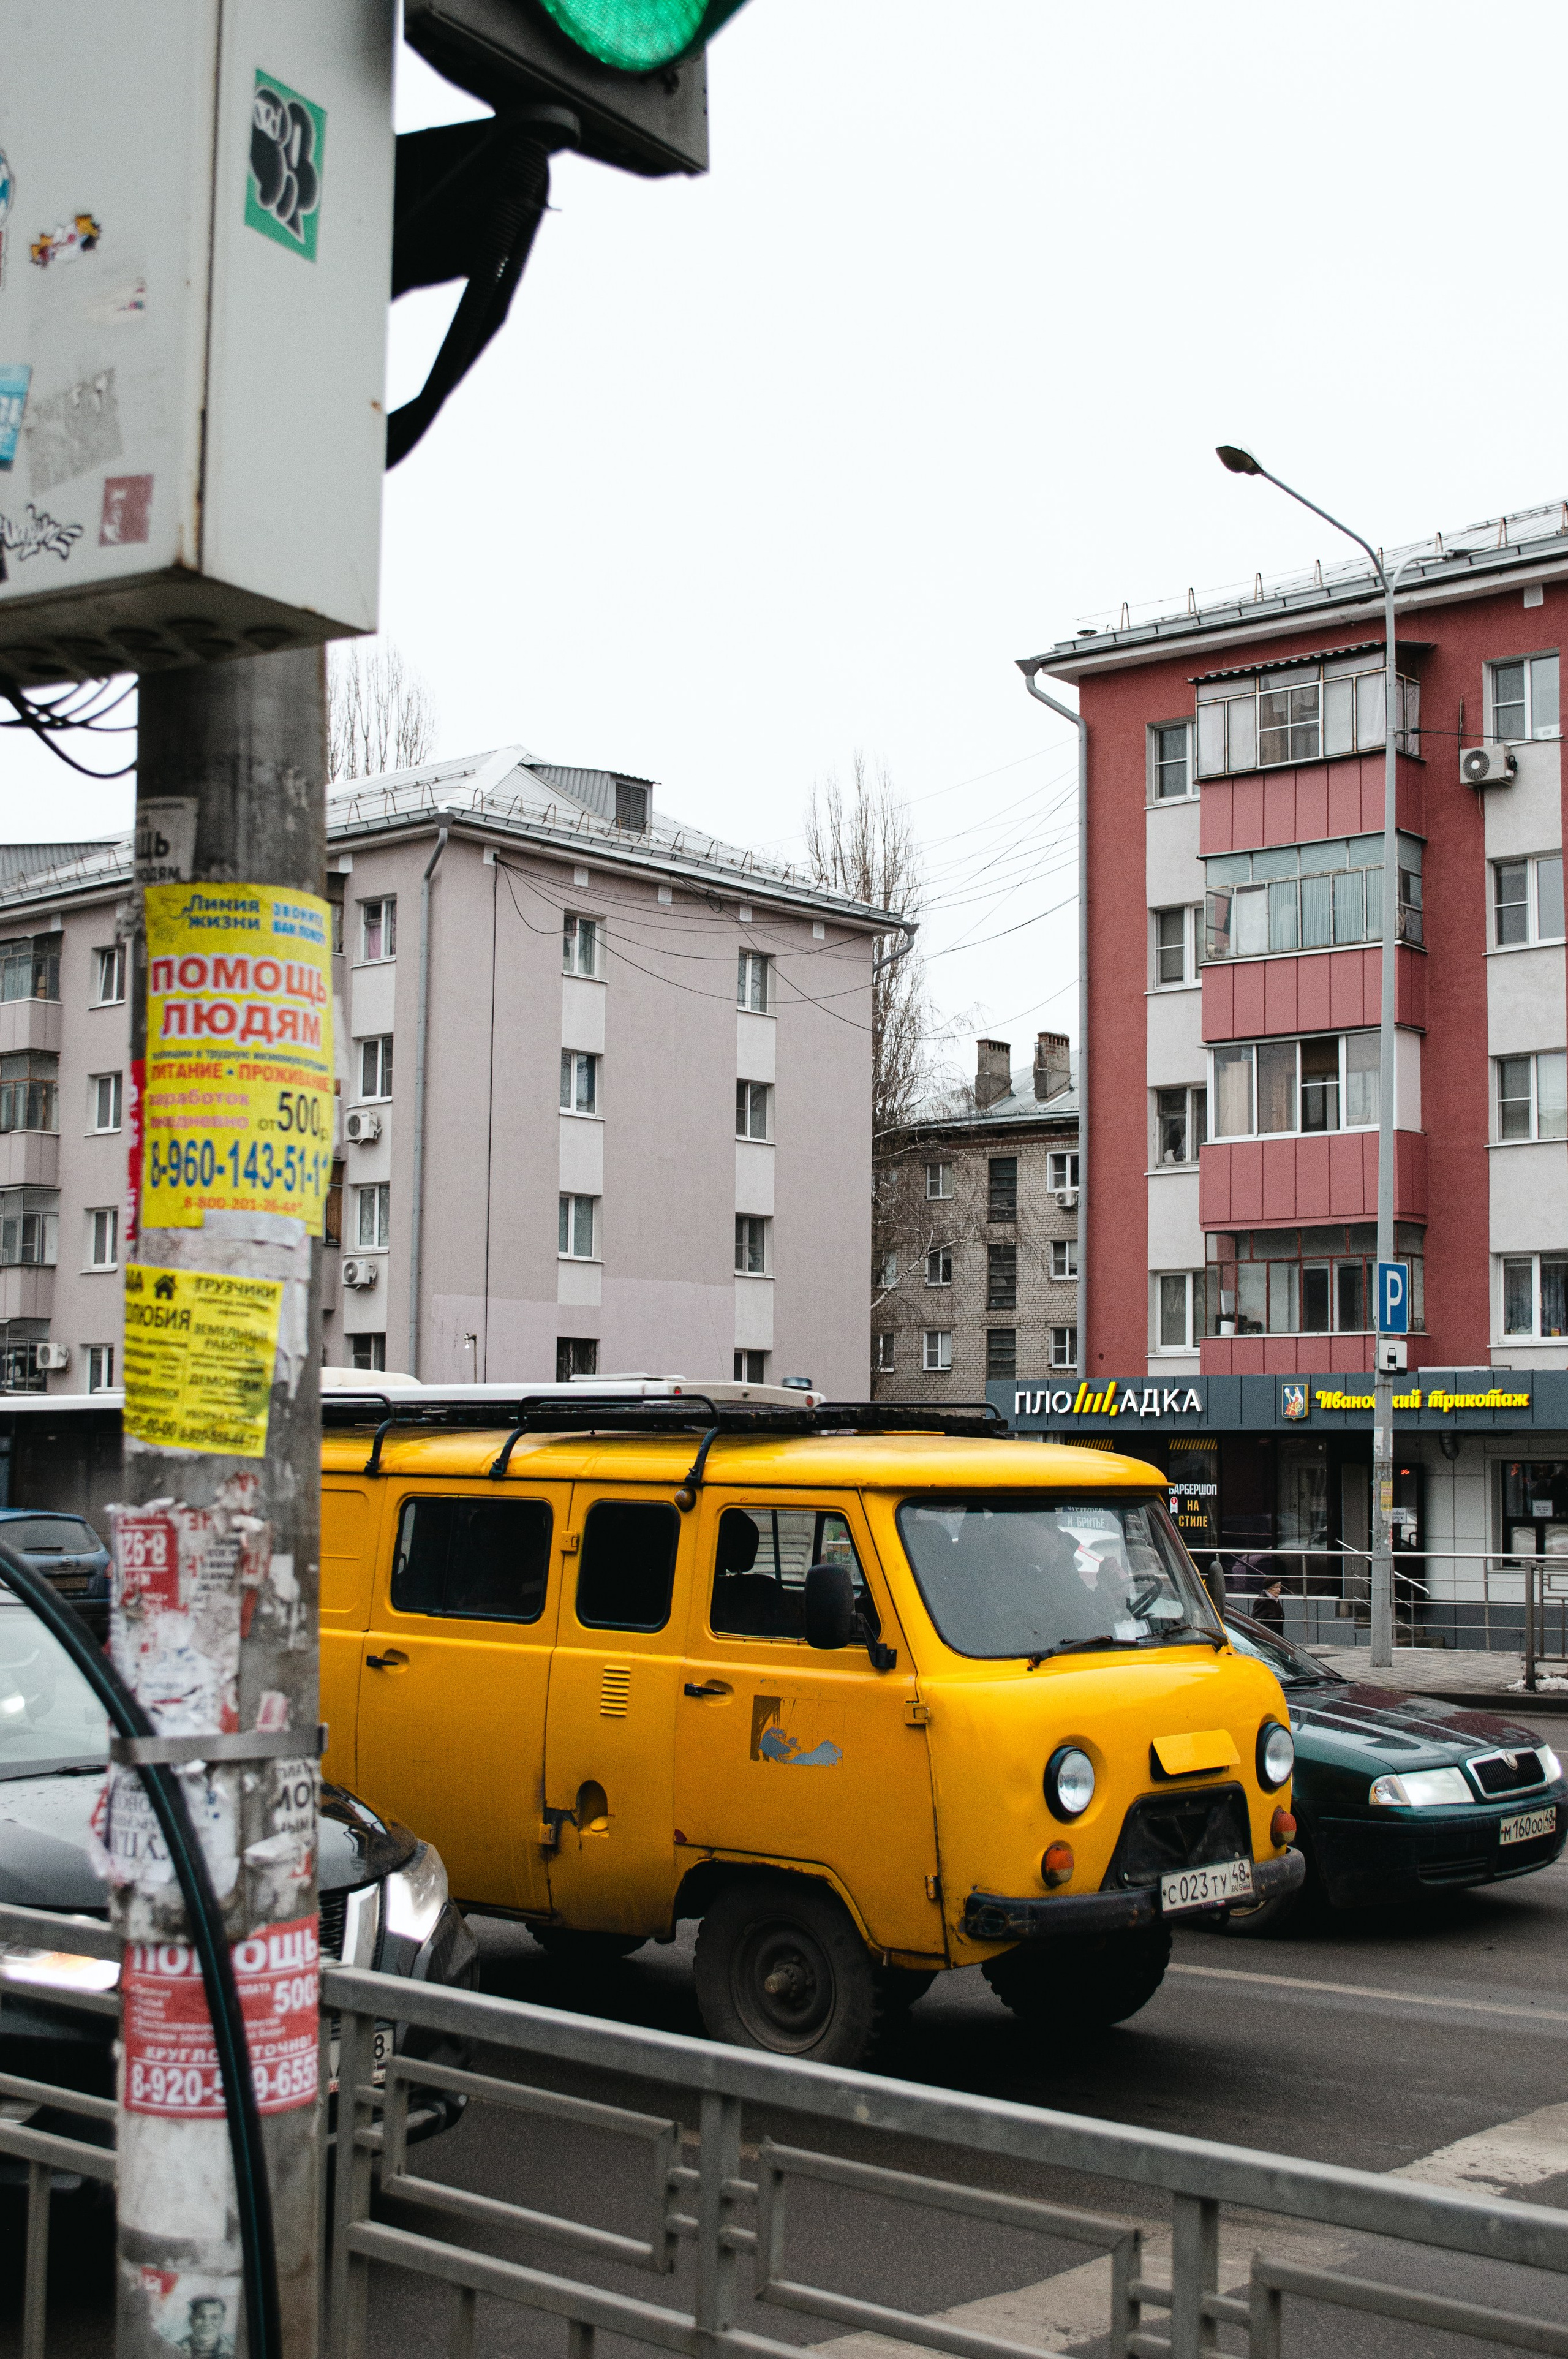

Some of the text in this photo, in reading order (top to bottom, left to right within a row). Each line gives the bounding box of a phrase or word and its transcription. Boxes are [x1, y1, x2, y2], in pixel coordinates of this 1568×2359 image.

[183, 894, 260, 913] Линия
[189, 916, 260, 930] жизни
[151, 956, 328, 1006] ПОМОЩЬ
[162, 1002, 322, 1047] ЛЮДЯМ
[1387, 1270, 1403, 1325] P
[1014, 1381, 1204, 1417] ПЛОЩАДКА
[1315, 1389, 1529, 1413] Иванокий трикотаж
[1186, 1500, 1199, 1511] НА
[1076, 1516, 1106, 1528] БРИТЬЕ
[1178, 1515, 1208, 1527] СТИЛЕ
[1232, 1862, 1246, 1883] 48
[374, 2034, 385, 2059] 8
